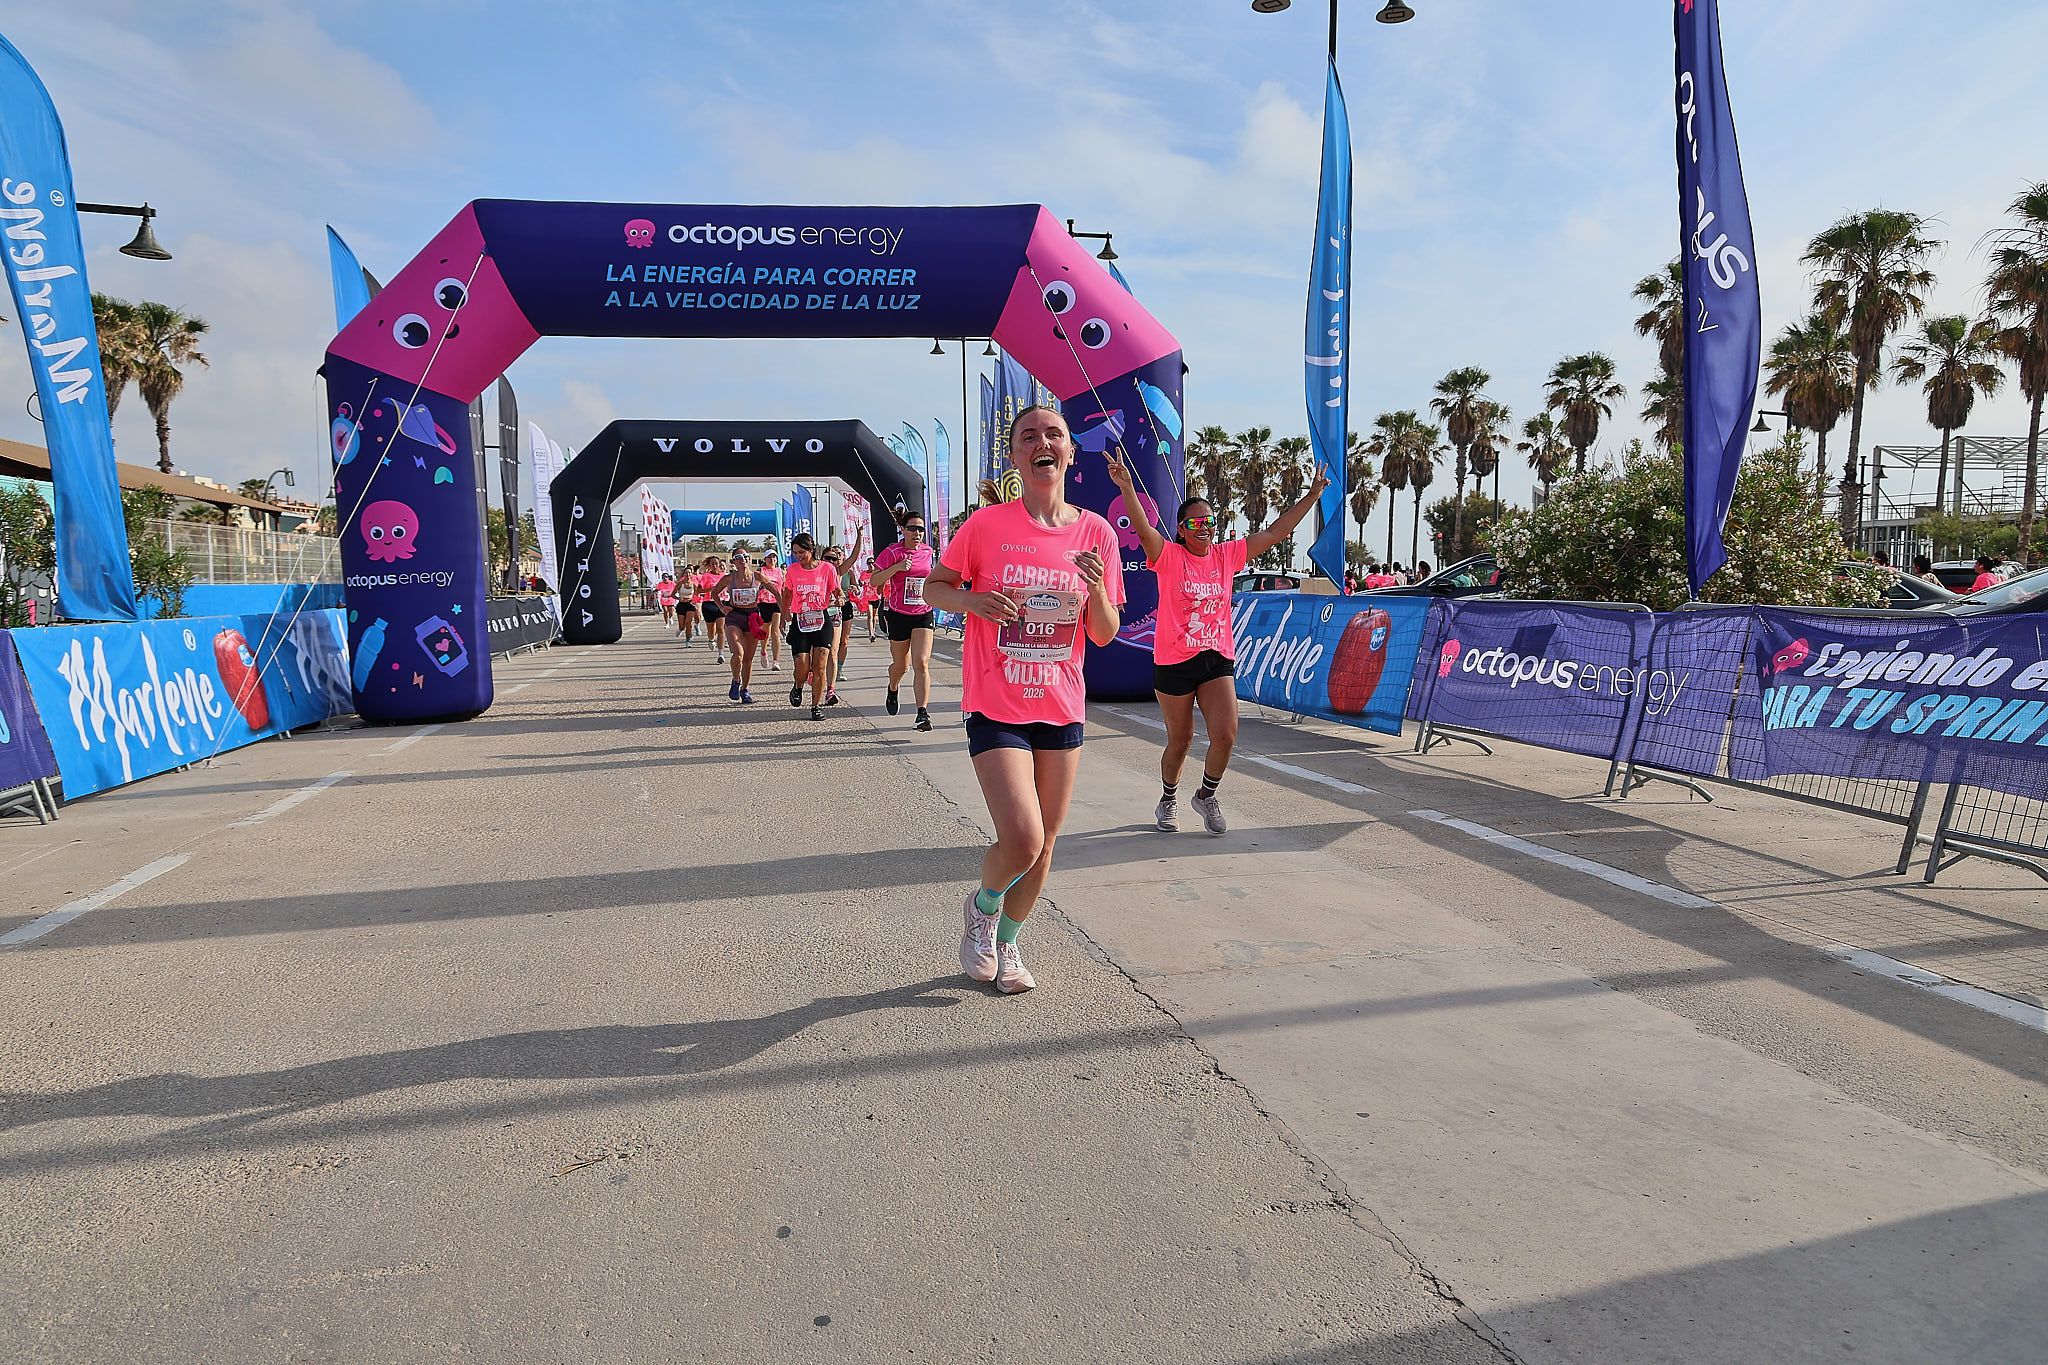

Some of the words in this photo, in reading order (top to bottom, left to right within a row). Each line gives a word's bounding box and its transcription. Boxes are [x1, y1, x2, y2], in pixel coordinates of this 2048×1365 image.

[668, 223, 796, 251] octopus
[801, 227, 904, 255] energy
[606, 264, 636, 282] LA
[643, 262, 746, 284] ENERGÍA
[753, 267, 816, 285] PARA
[823, 268, 917, 286] CORRER
[0, 177, 94, 405] Marlene
[605, 291, 622, 307] A
[628, 291, 658, 308] LA
[666, 292, 800, 309] VELOCIDAD
[805, 294, 836, 310] DE
[841, 294, 870, 310] LA
[876, 294, 921, 310] LUZ
[652, 438, 824, 453] VOLVO
[705, 512, 751, 532] Marlene
[1001, 543, 1037, 554] OYSHO
[573, 504, 594, 628] VOLVO
[1002, 563, 1079, 591] CARRERA
[347, 574, 397, 590] octopus
[399, 571, 455, 587] energy
[1025, 622, 1055, 635] 016
[1006, 650, 1032, 658] OYSHO
[1803, 639, 2013, 689] Cogiendo
[2011, 660, 2048, 692] e
[1004, 661, 1060, 686] MUJER
[1462, 646, 1578, 689] octopus
[1578, 663, 1690, 717] energy
[1023, 687, 1045, 699] 2026
[57, 631, 222, 782] Marlene
[1762, 685, 1834, 732] PARA
[1830, 687, 1906, 731] TU
[1891, 693, 2048, 746] SPRIN
